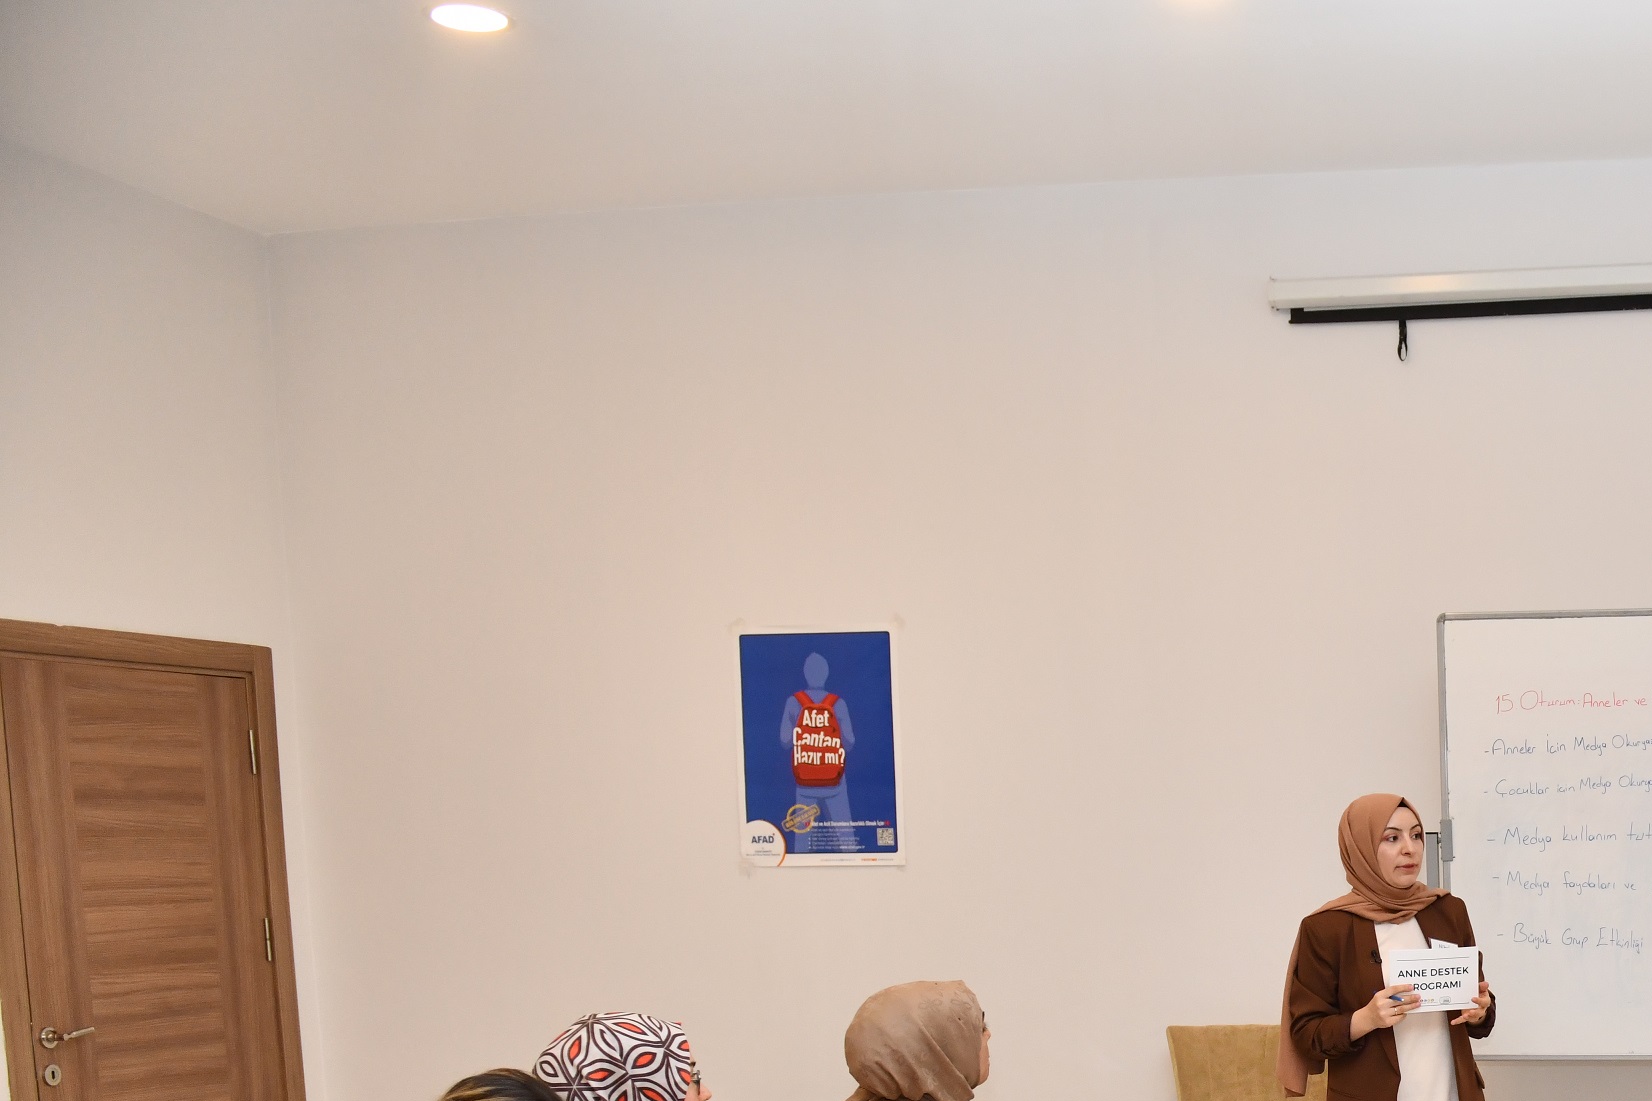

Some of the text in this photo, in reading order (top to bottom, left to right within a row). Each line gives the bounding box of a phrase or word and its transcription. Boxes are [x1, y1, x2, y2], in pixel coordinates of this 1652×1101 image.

[1634, 697, 1648, 707] ve
[802, 709, 830, 728] Afet
[793, 745, 846, 767] Hazır mı?
[1573, 736, 1607, 757] Medya
[1494, 778, 1550, 798] Çocuklar
[1579, 776, 1612, 795] Medya
[751, 835, 775, 844] AFAD
[1503, 826, 1552, 852] Medya
[1562, 824, 1617, 843] kullanım
[1506, 870, 1551, 896] Medya
[1623, 882, 1637, 891] ve
[1512, 922, 1552, 950] Büyük
[1561, 927, 1589, 949] Grup
[1397, 966, 1469, 978] ANNE DESTEK
[1413, 980, 1461, 991] ROGRAMI
